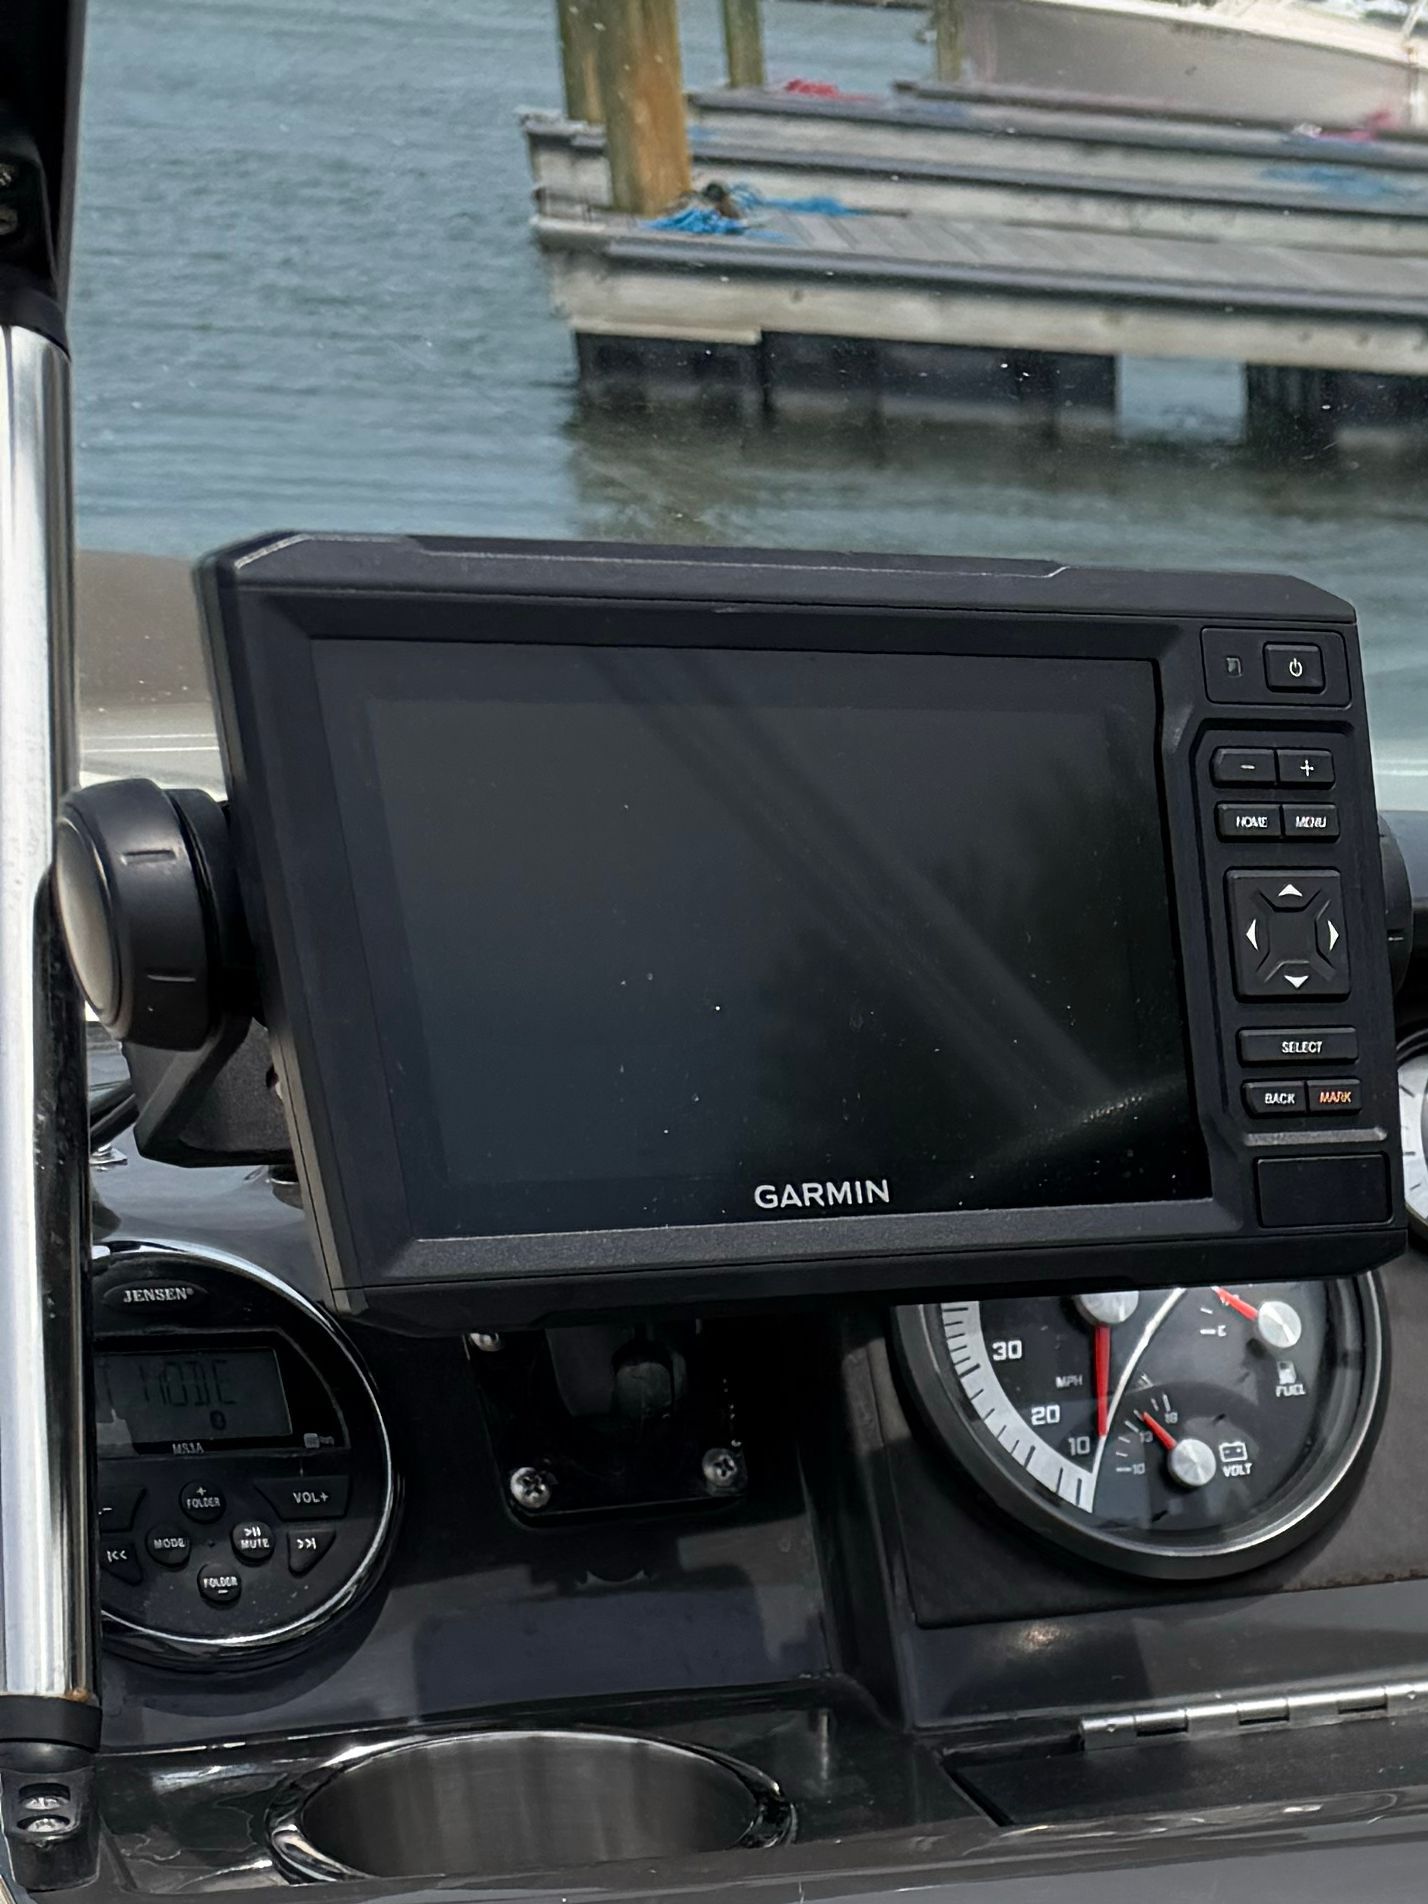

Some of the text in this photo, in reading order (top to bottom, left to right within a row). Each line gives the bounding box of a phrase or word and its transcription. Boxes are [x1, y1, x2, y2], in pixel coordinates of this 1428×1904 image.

[1236, 816, 1268, 829] HOME
[1295, 816, 1327, 829] MENU
[1281, 1041, 1323, 1054] SELECT
[1264, 1092, 1296, 1105] BACK
[1319, 1091, 1352, 1104] MARK
[754, 1179, 890, 1209] GARMIN
[992, 1340, 1023, 1361] 30
[1055, 1375, 1084, 1389] MPH
[1275, 1382, 1307, 1397] FUEL
[1031, 1404, 1061, 1425] 20
[1068, 1435, 1091, 1456] 10
[1132, 1463, 1146, 1475] 10
[1223, 1462, 1254, 1478] VOLT
[186, 1497, 221, 1509] FOLDER
[292, 1491, 330, 1504] VOL+
[153, 1538, 186, 1549] MODE
[240, 1538, 271, 1549] MUTE
[203, 1576, 239, 1588] FOLDER
